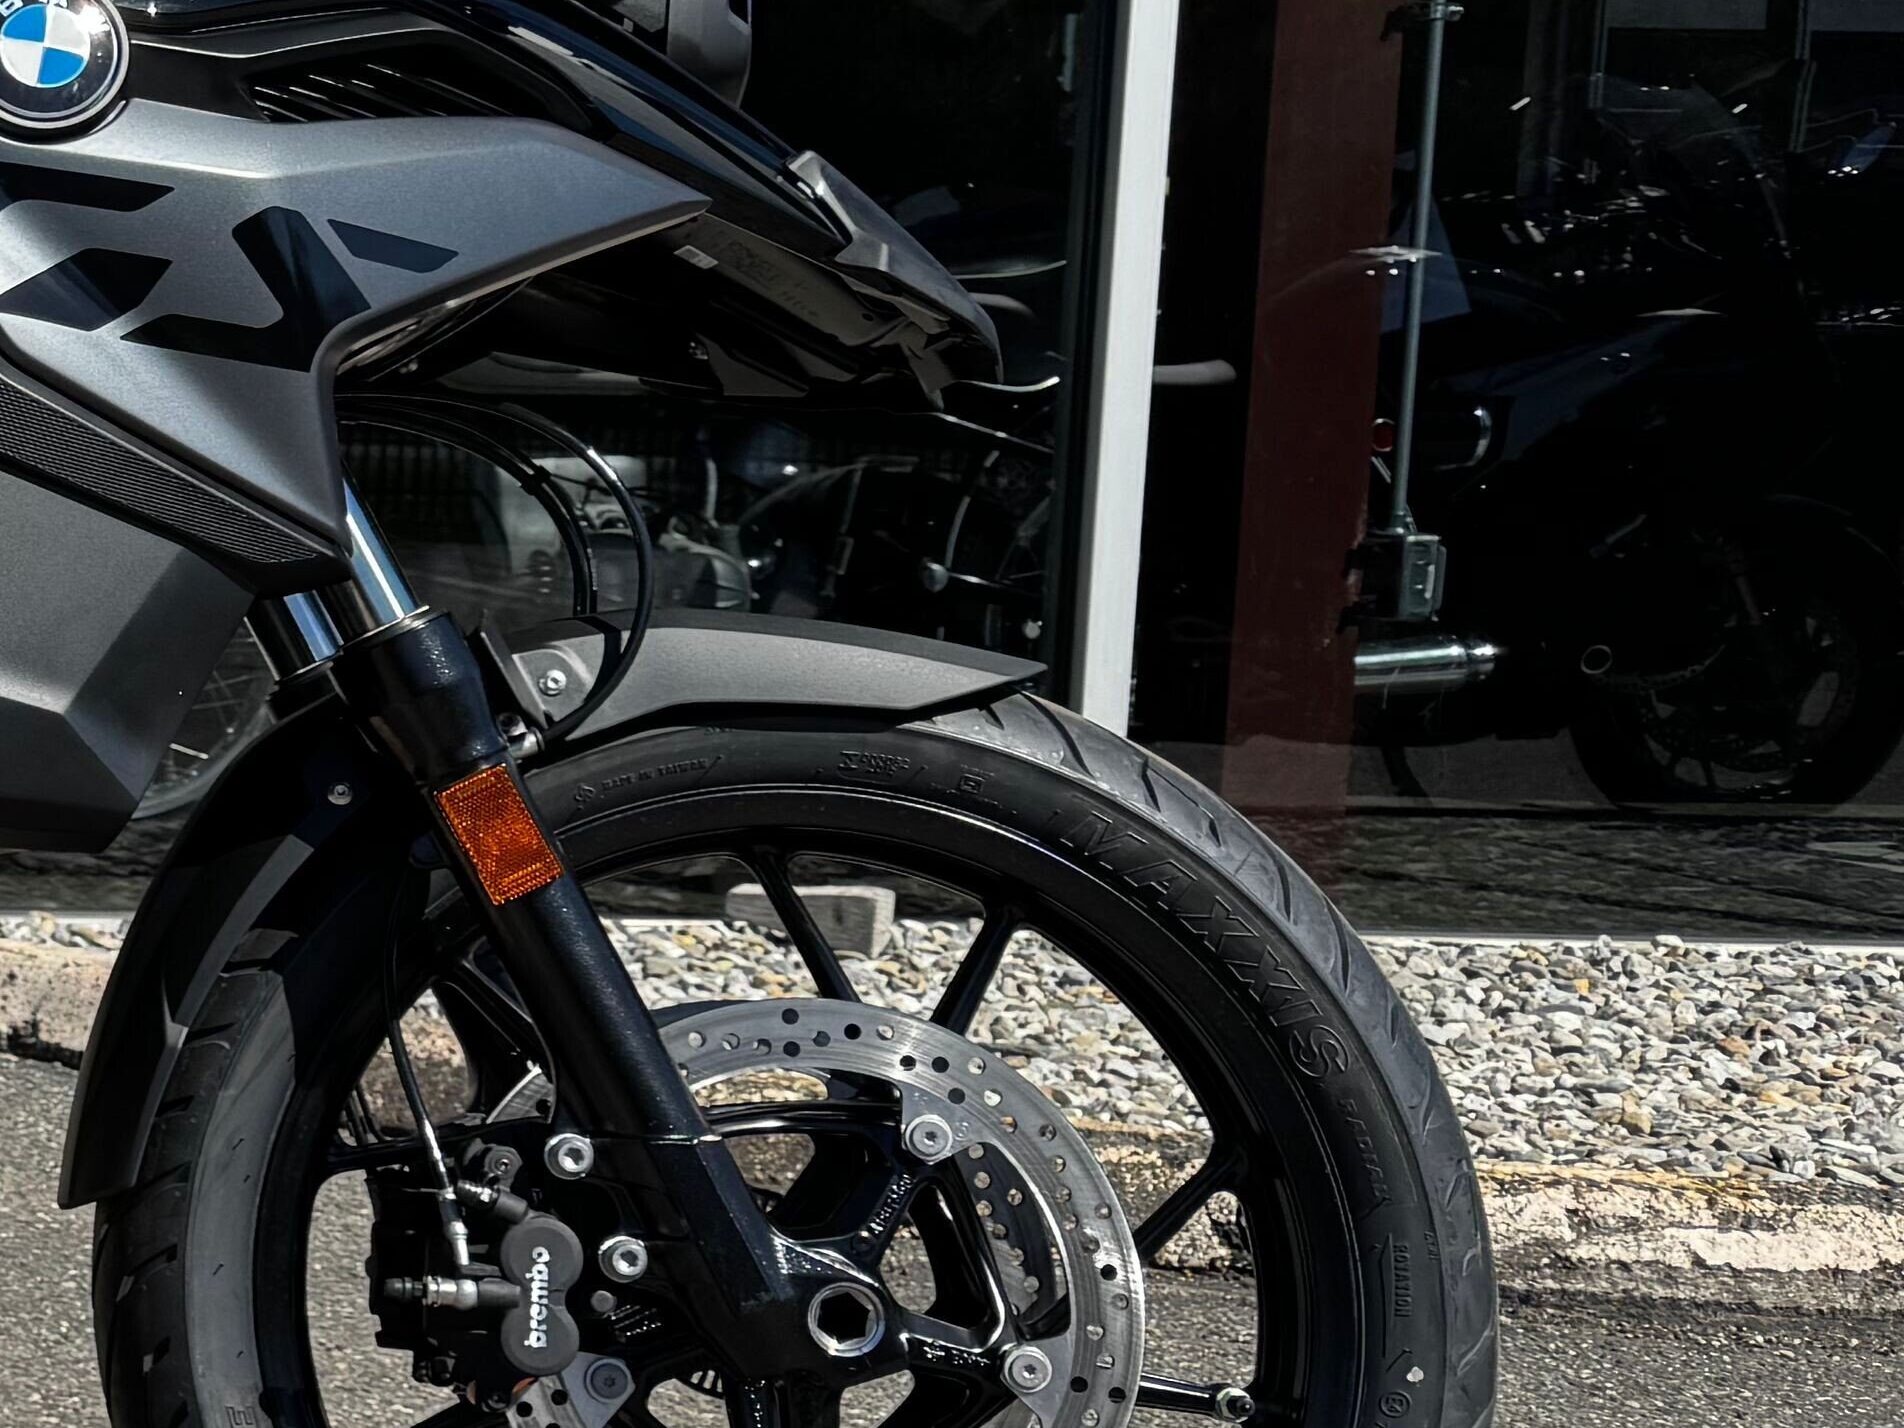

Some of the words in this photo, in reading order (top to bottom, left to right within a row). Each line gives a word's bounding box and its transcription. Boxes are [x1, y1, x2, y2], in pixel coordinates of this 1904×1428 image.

[1058, 812, 1349, 1080] MAXXIS
[1339, 1101, 1387, 1202] RADIAL
[524, 1246, 550, 1348] brembo
[1393, 1243, 1411, 1317] ROTATION
